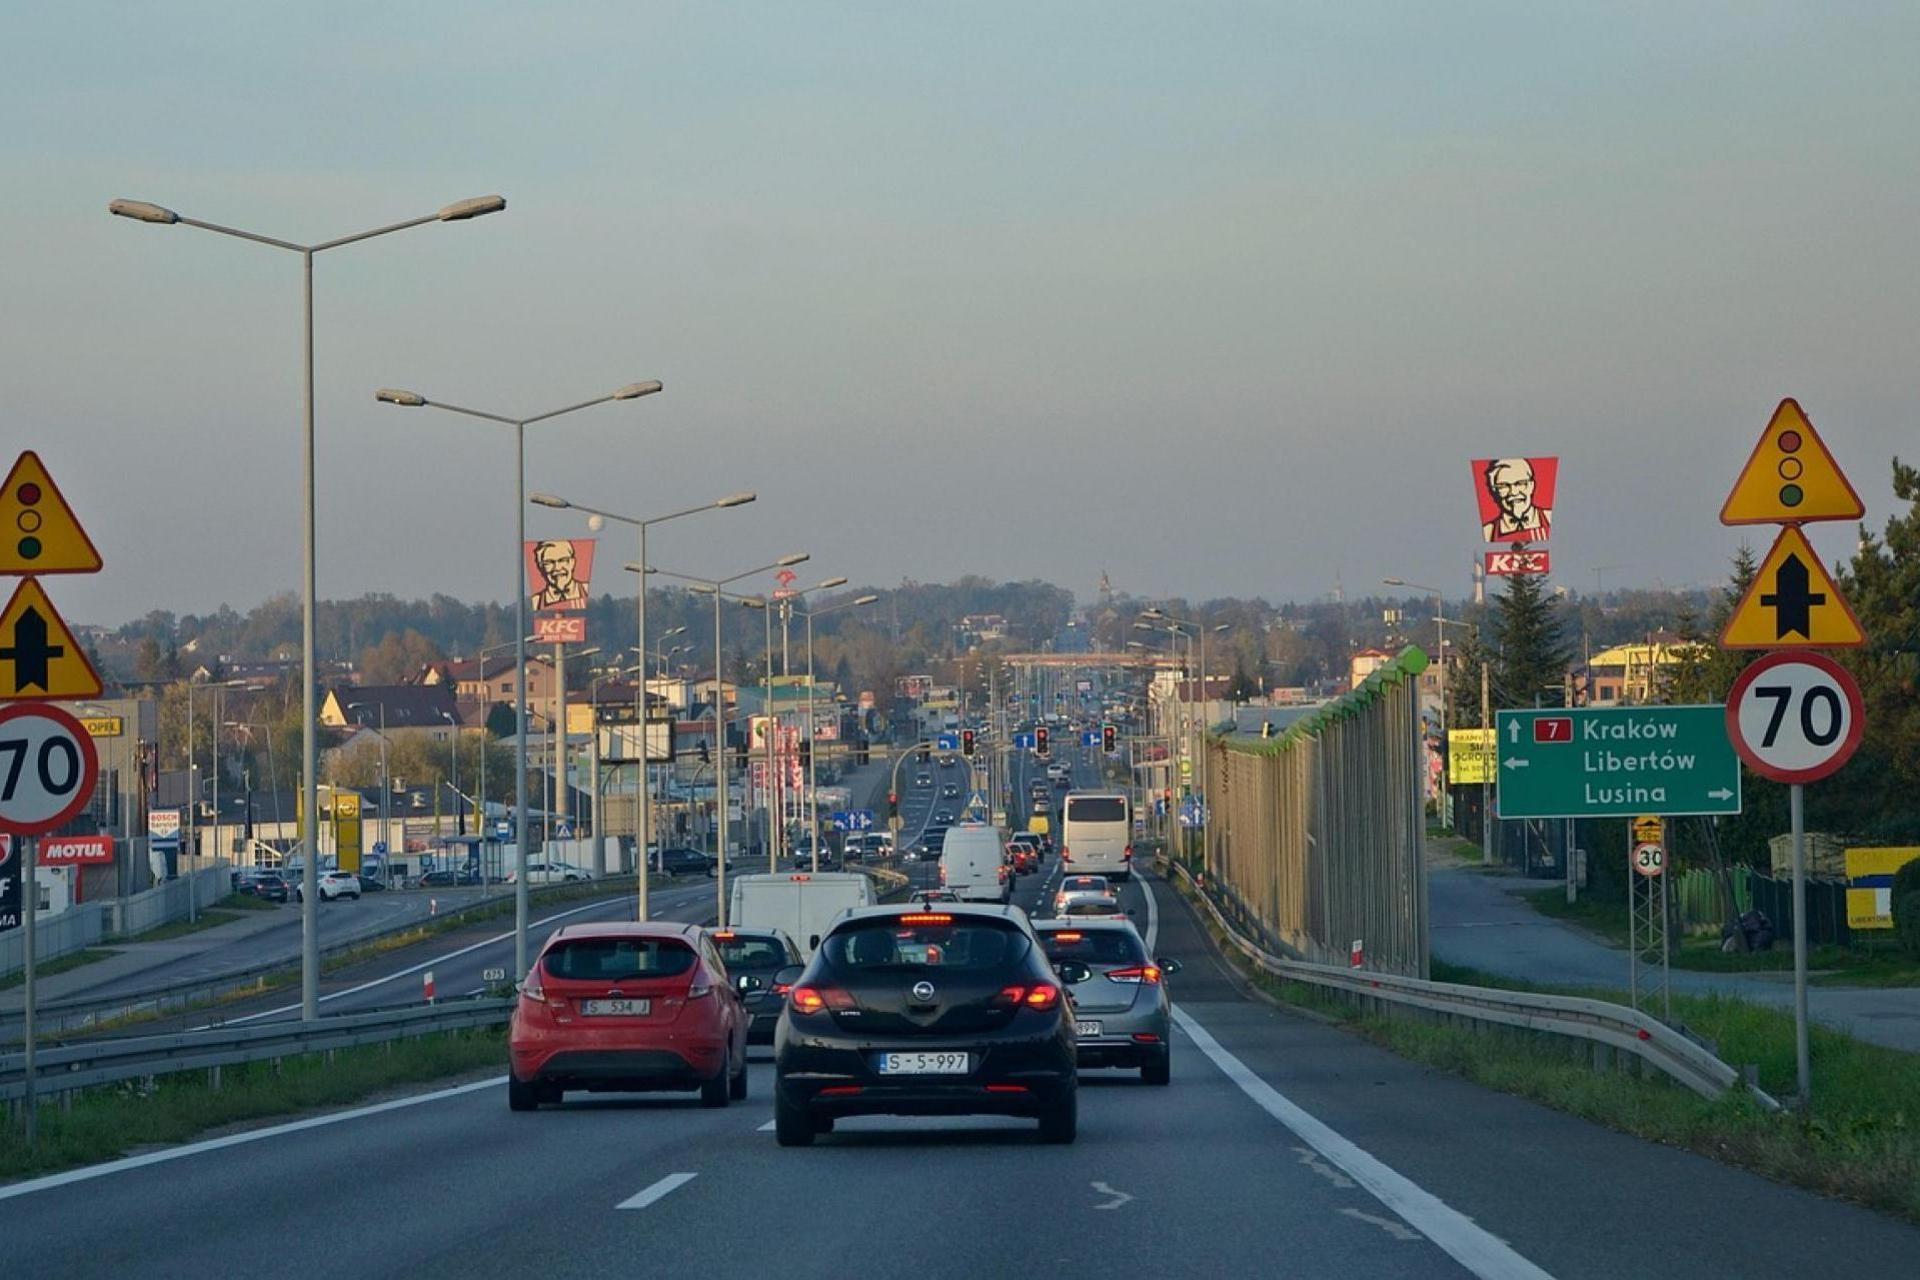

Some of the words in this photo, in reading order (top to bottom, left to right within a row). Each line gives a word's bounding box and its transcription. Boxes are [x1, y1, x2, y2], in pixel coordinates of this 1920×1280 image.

[540, 619, 580, 634] KFC
[1755, 685, 1842, 748] 70
[88, 721, 117, 733] OPEL
[1548, 722, 1559, 739] 7
[1583, 718, 1677, 741] Kraków
[0, 735, 79, 800] 70
[1584, 749, 1696, 772] Libertów
[1585, 782, 1667, 804] Lusina
[46, 843, 105, 859] MOTUL
[1640, 849, 1662, 867] 30
[590, 1002, 598, 1012] S
[611, 1001, 633, 1012] 534
